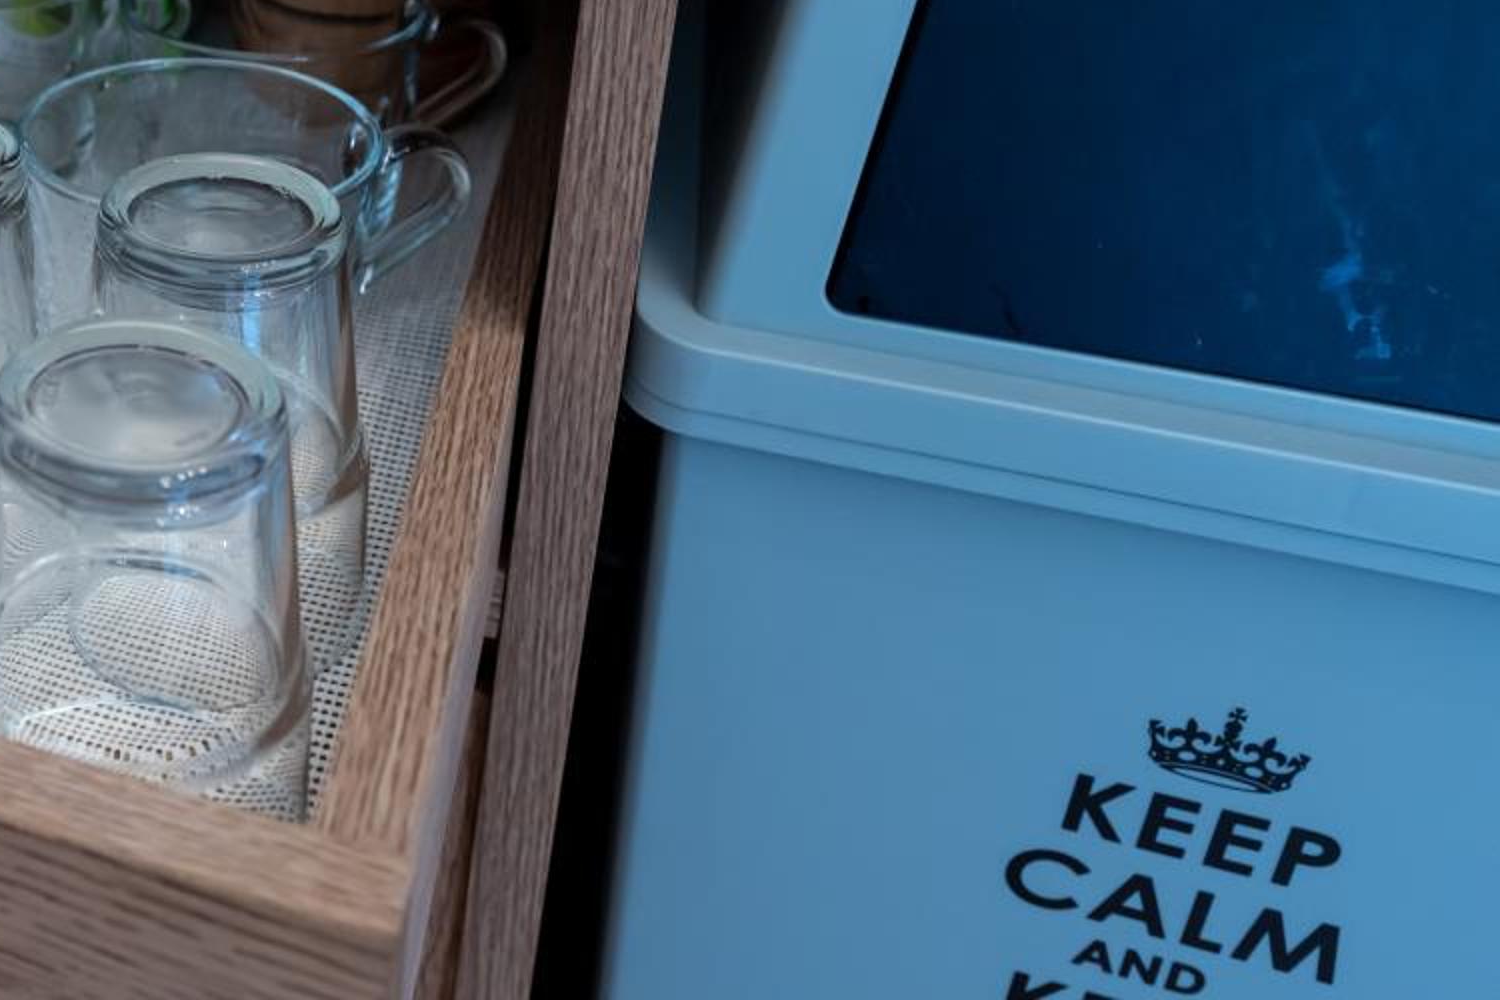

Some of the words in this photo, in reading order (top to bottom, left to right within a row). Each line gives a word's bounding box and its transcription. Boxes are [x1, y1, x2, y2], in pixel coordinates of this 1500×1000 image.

[1060, 772, 1342, 887] KEEP
[1003, 848, 1342, 985] CALM
[1070, 938, 1207, 995] AND
